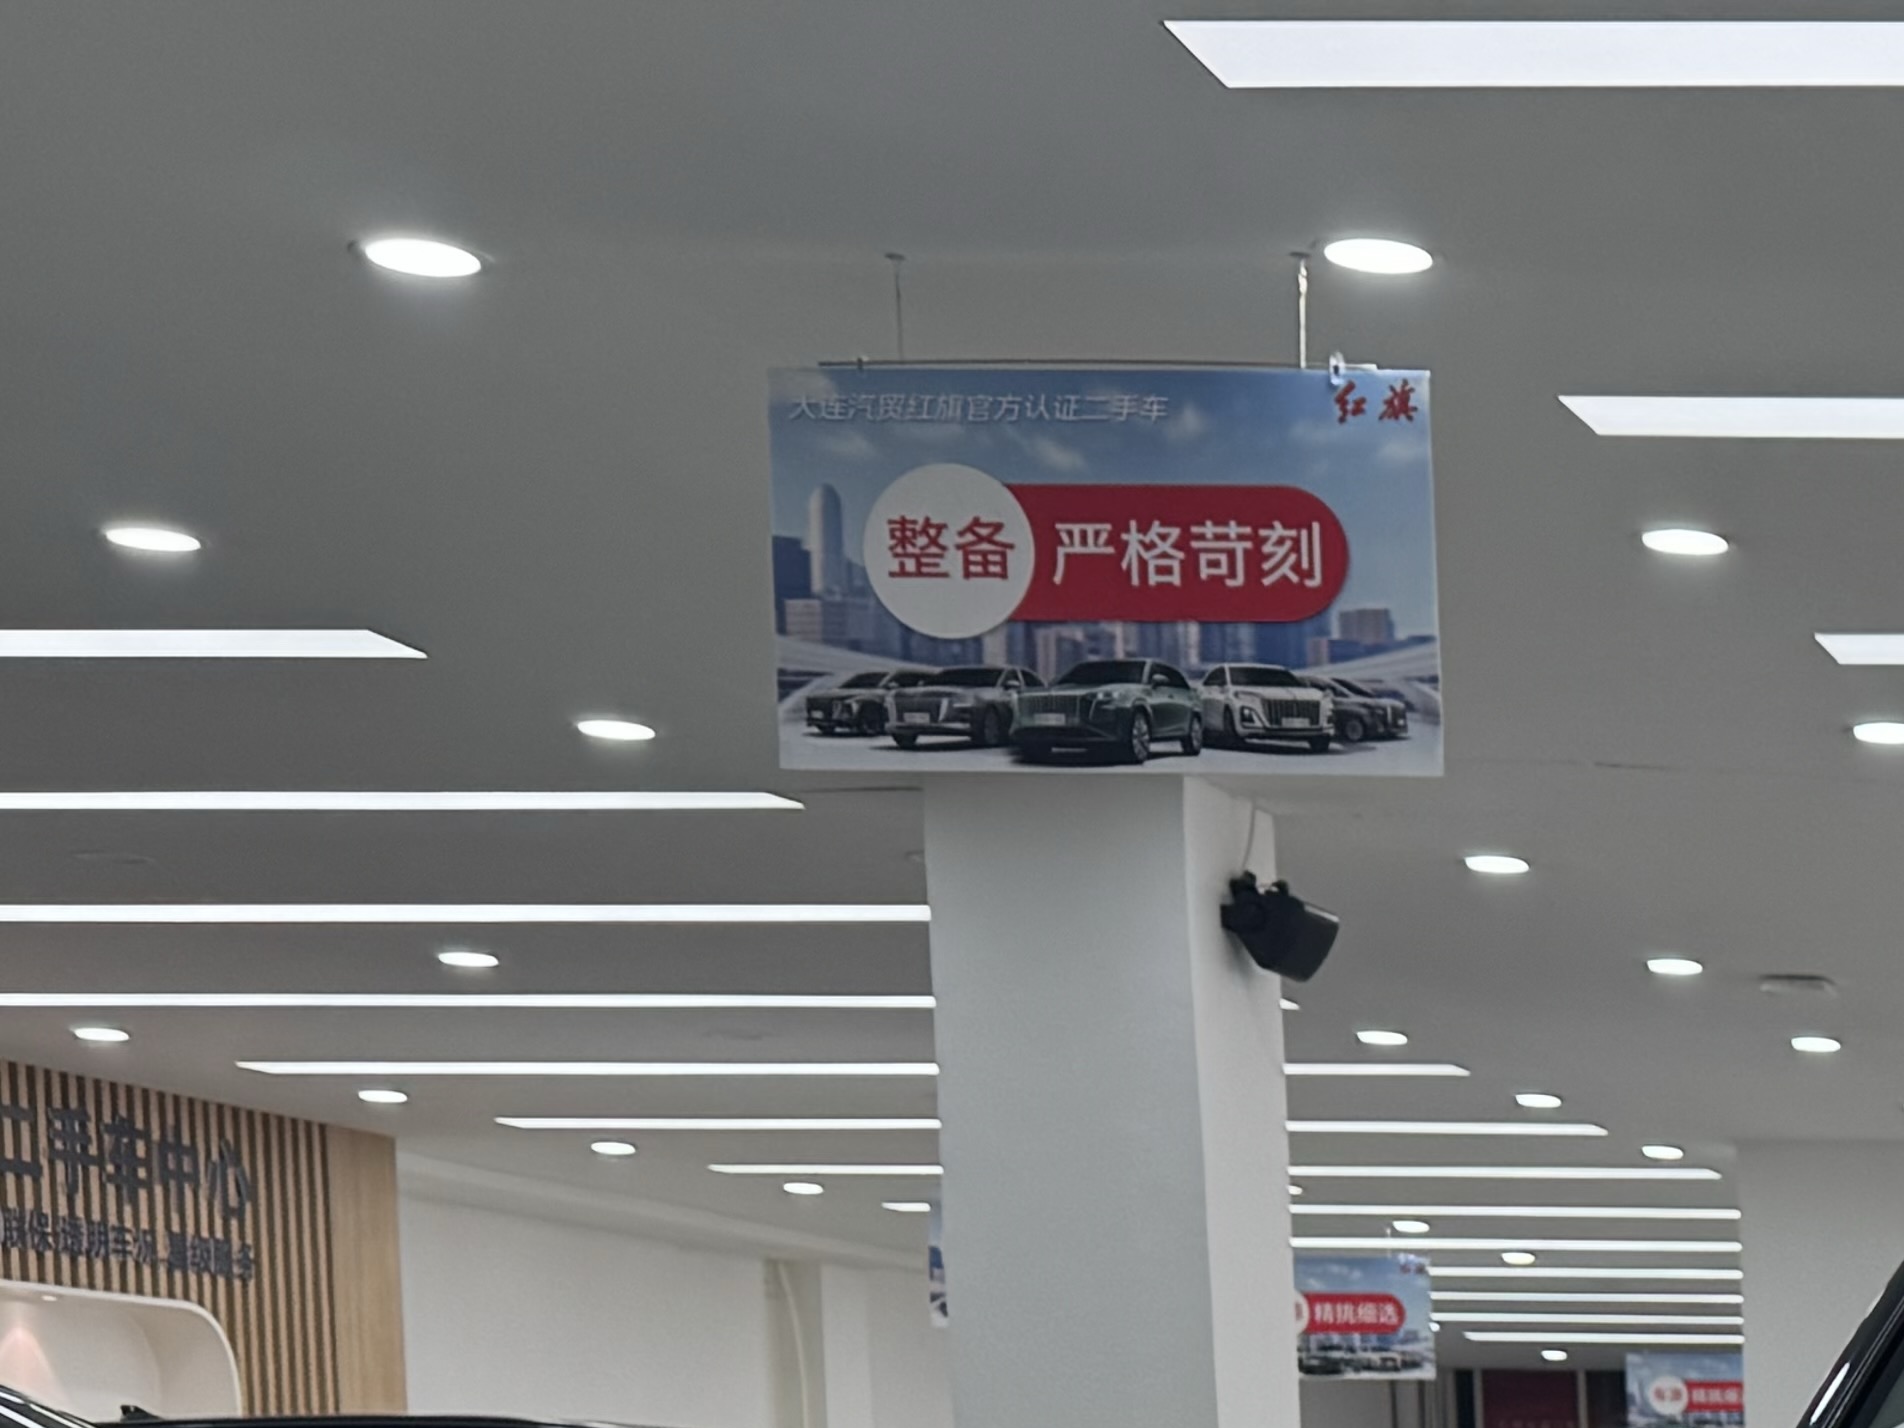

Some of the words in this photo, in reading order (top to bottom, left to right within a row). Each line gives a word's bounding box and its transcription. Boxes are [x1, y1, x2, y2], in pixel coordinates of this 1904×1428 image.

[886, 515, 1016, 580] 整备
[1053, 519, 1322, 588] 严格苛刻
